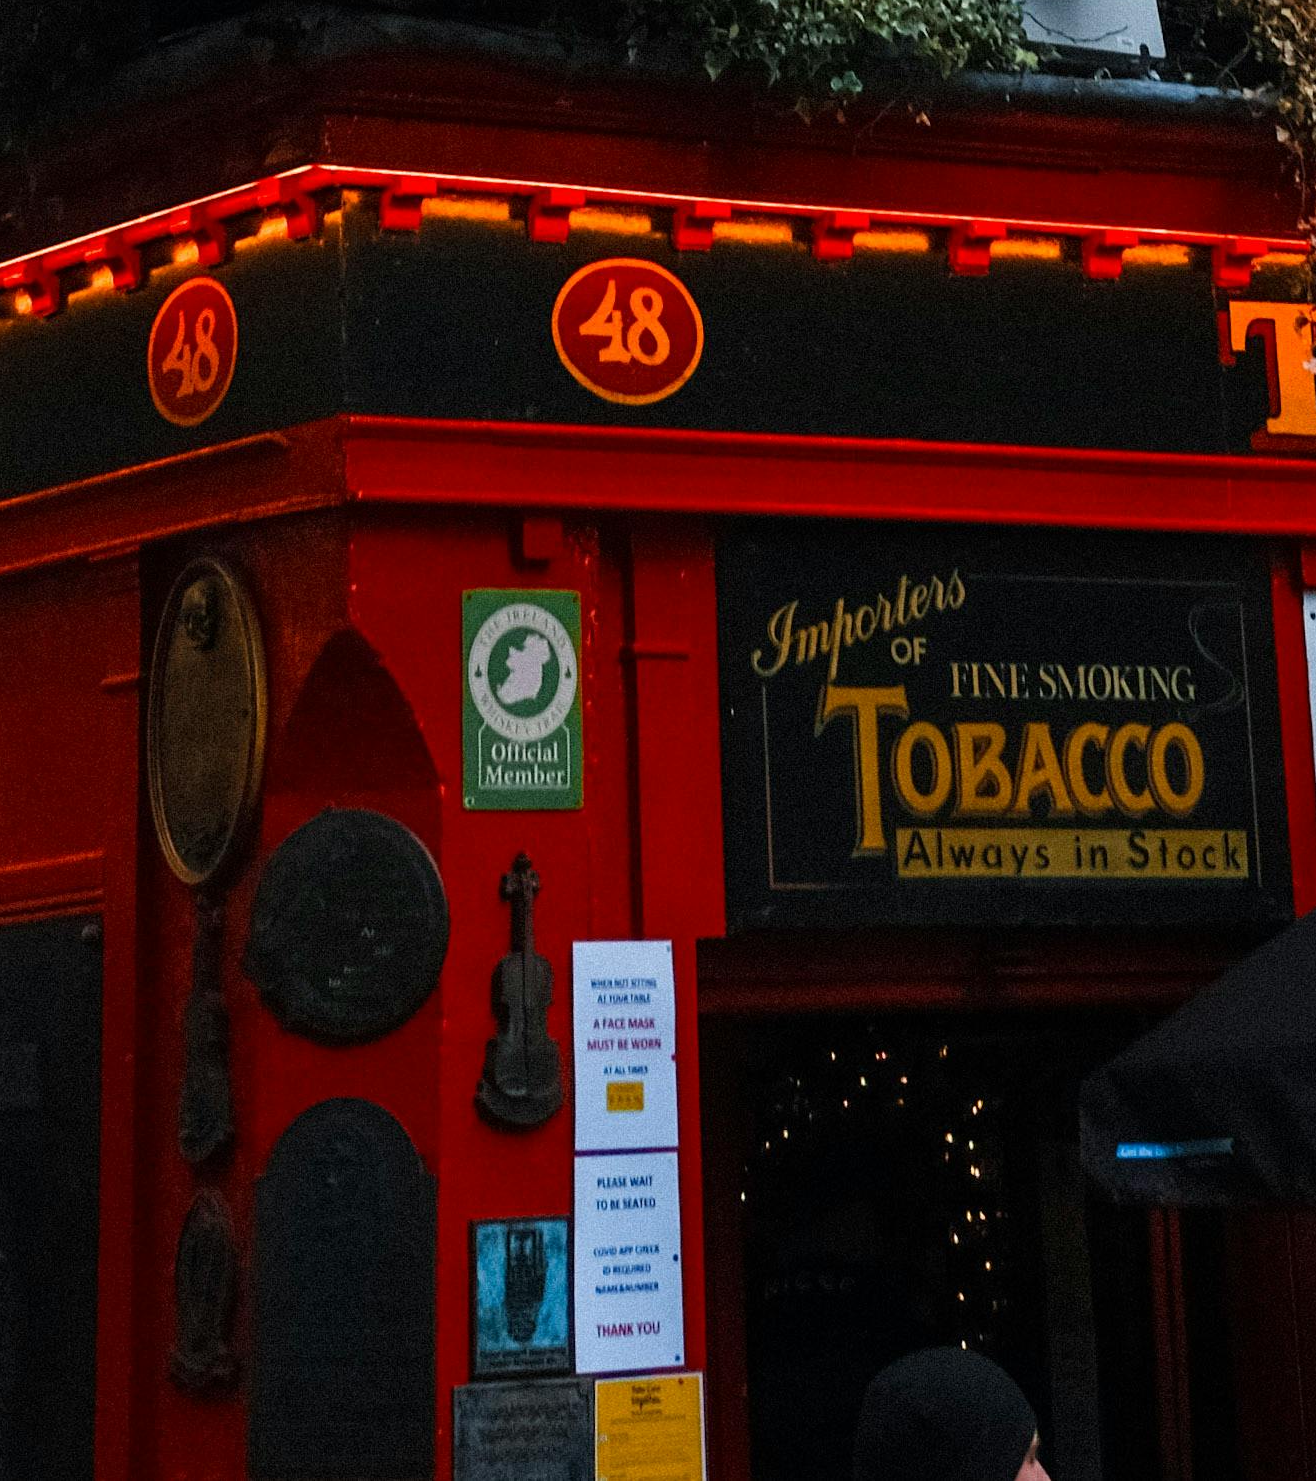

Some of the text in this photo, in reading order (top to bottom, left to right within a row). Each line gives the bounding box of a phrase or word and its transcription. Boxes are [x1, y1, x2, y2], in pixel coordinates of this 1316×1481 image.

[579, 279, 672, 366] 48
[161, 307, 220, 399] 48
[751, 568, 967, 679] Importers
[890, 636, 928, 666] OF
[950, 661, 1197, 704] FINE SMOKING
[491, 742, 559, 764] Official
[485, 764, 565, 787] Member
[817, 684, 1206, 857] TOBACCO
[901, 829, 1243, 876] Always in Stock
[593, 1017, 656, 1030] A FACE MASK
[587, 1038, 662, 1052] MUST BE WORN
[597, 1176, 653, 1189] PLEASE WAIT
[596, 1197, 657, 1211] TO BE SEATED
[596, 1321, 661, 1338] THANK YOU
